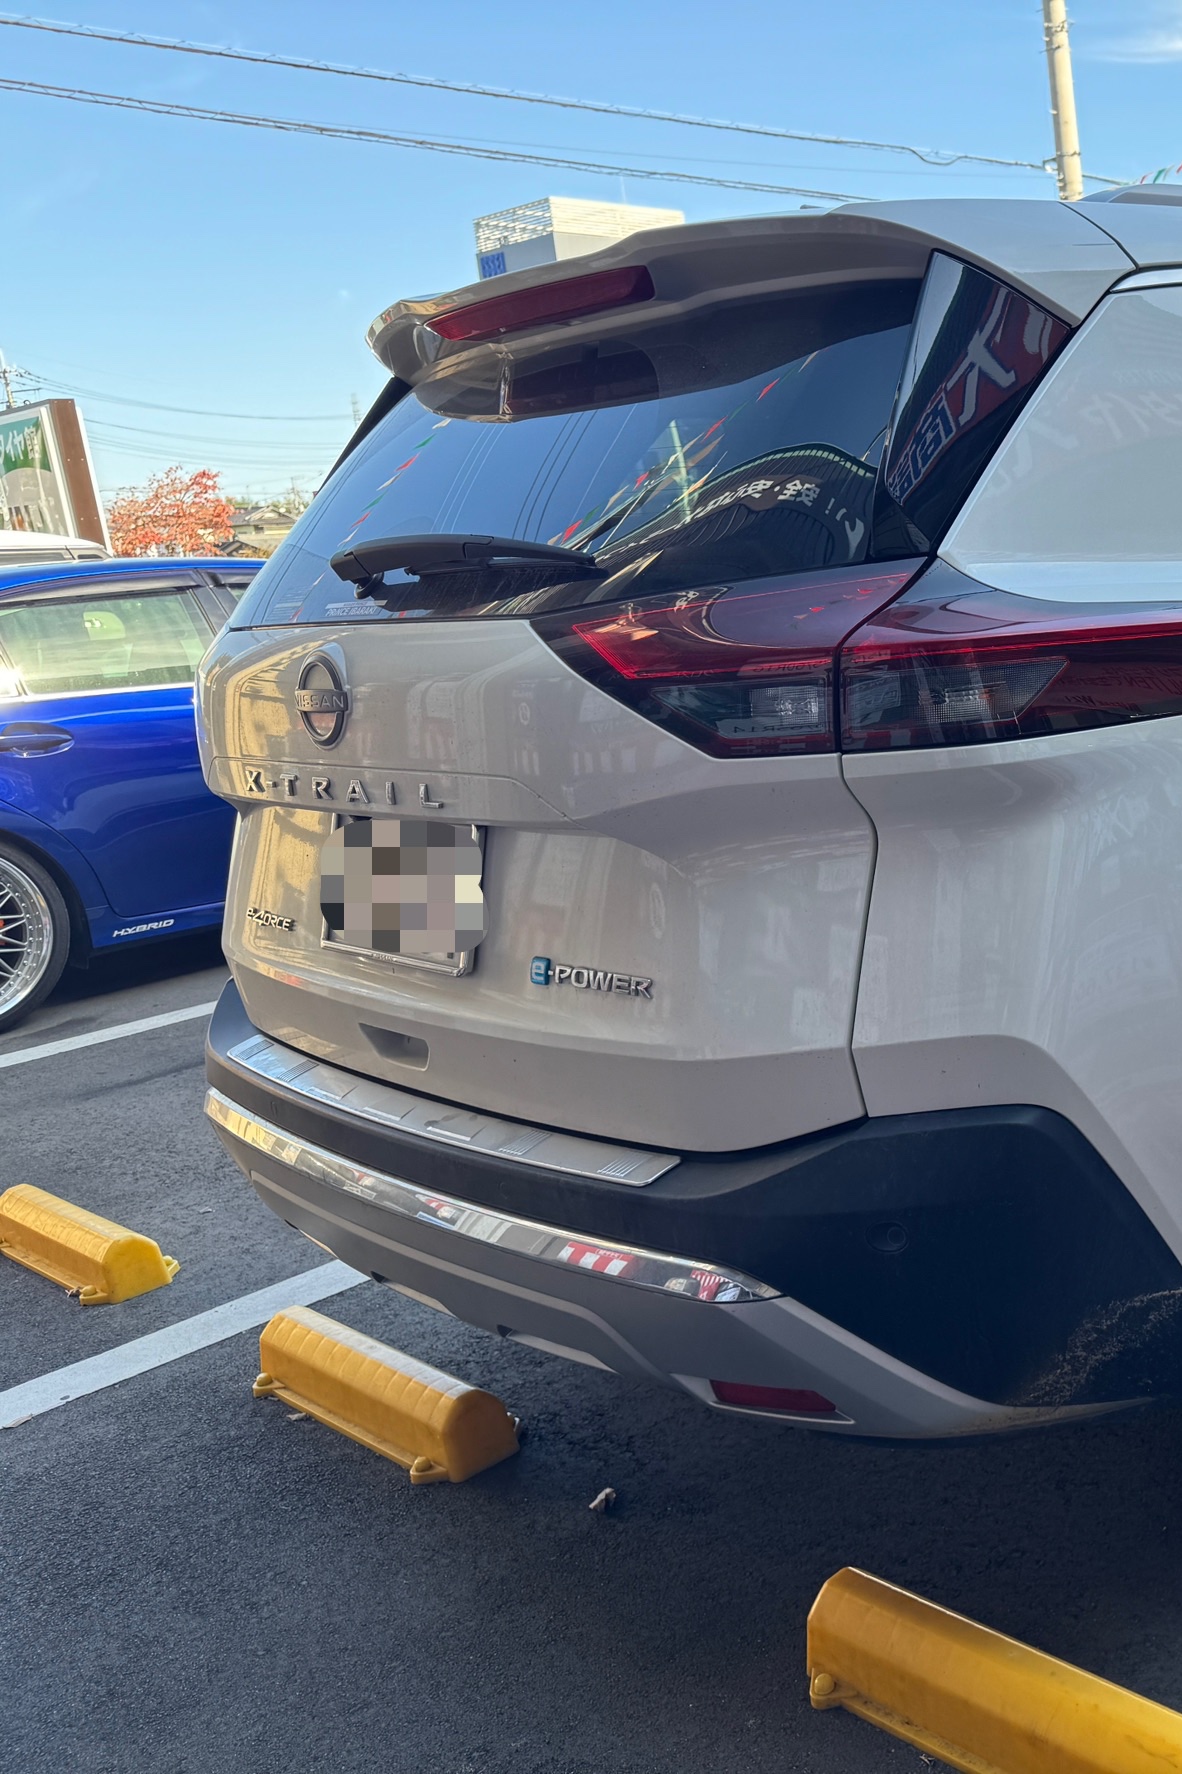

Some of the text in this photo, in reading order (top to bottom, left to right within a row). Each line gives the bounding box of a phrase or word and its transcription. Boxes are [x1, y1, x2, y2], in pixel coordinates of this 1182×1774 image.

[297, 694, 345, 709] NISSAN
[245, 769, 444, 809] X-TRAIL
[112, 918, 175, 938] HYBRID
[531, 957, 653, 999] e-POWER
